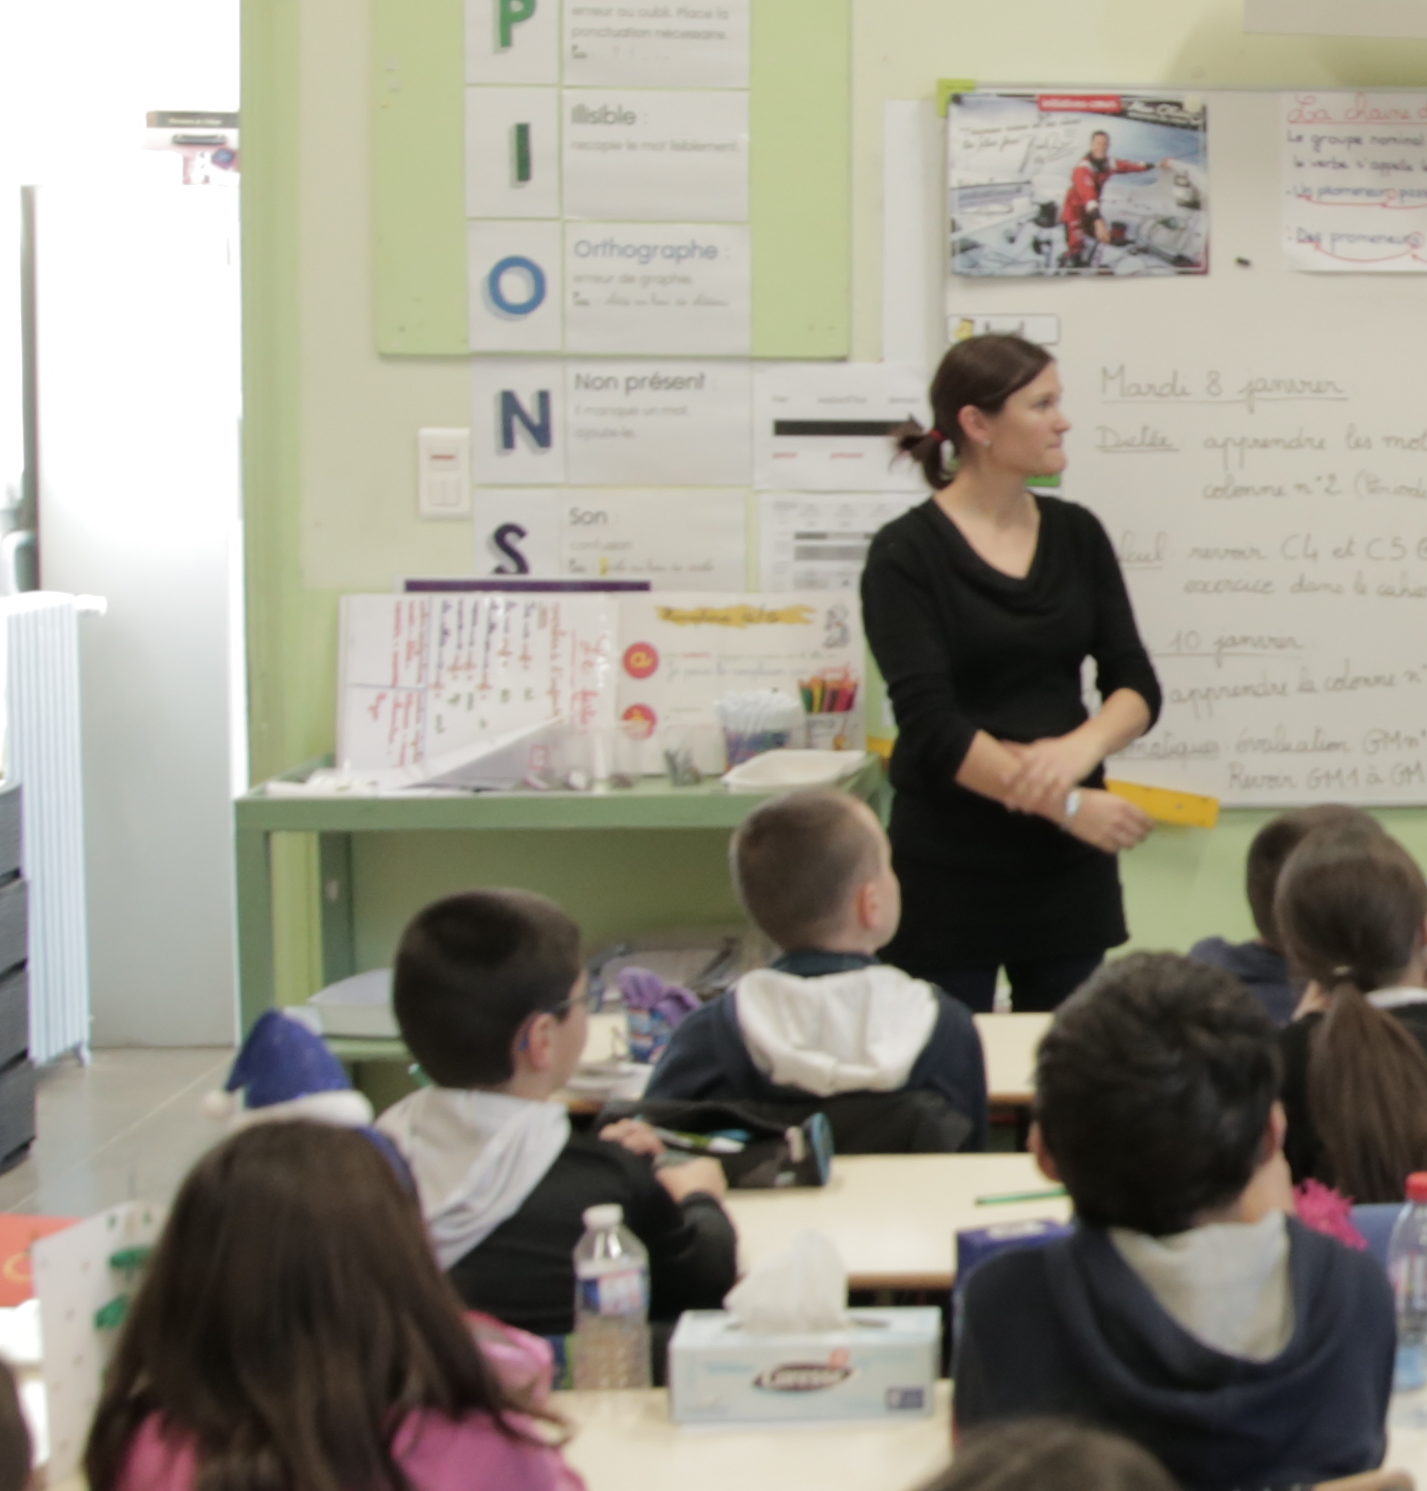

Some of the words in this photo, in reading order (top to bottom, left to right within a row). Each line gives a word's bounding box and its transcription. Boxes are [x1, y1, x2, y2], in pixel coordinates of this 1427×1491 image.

[499, 0, 538, 48] P
[1310, 133, 1364, 153] groupe
[573, 238, 720, 265] Orthographe
[487, 253, 549, 315] O
[573, 372, 620, 391] Non
[624, 371, 707, 397] présent
[1099, 362, 1194, 399] Mardi
[1204, 369, 1224, 397] 8
[1236, 374, 1347, 416] janvier
[501, 387, 554, 450] N
[1201, 426, 1330, 472] apprendre
[1345, 421, 1373, 451] les
[569, 506, 609, 526] Son
[490, 521, 532, 576] S
[1332, 535, 1357, 559] et
